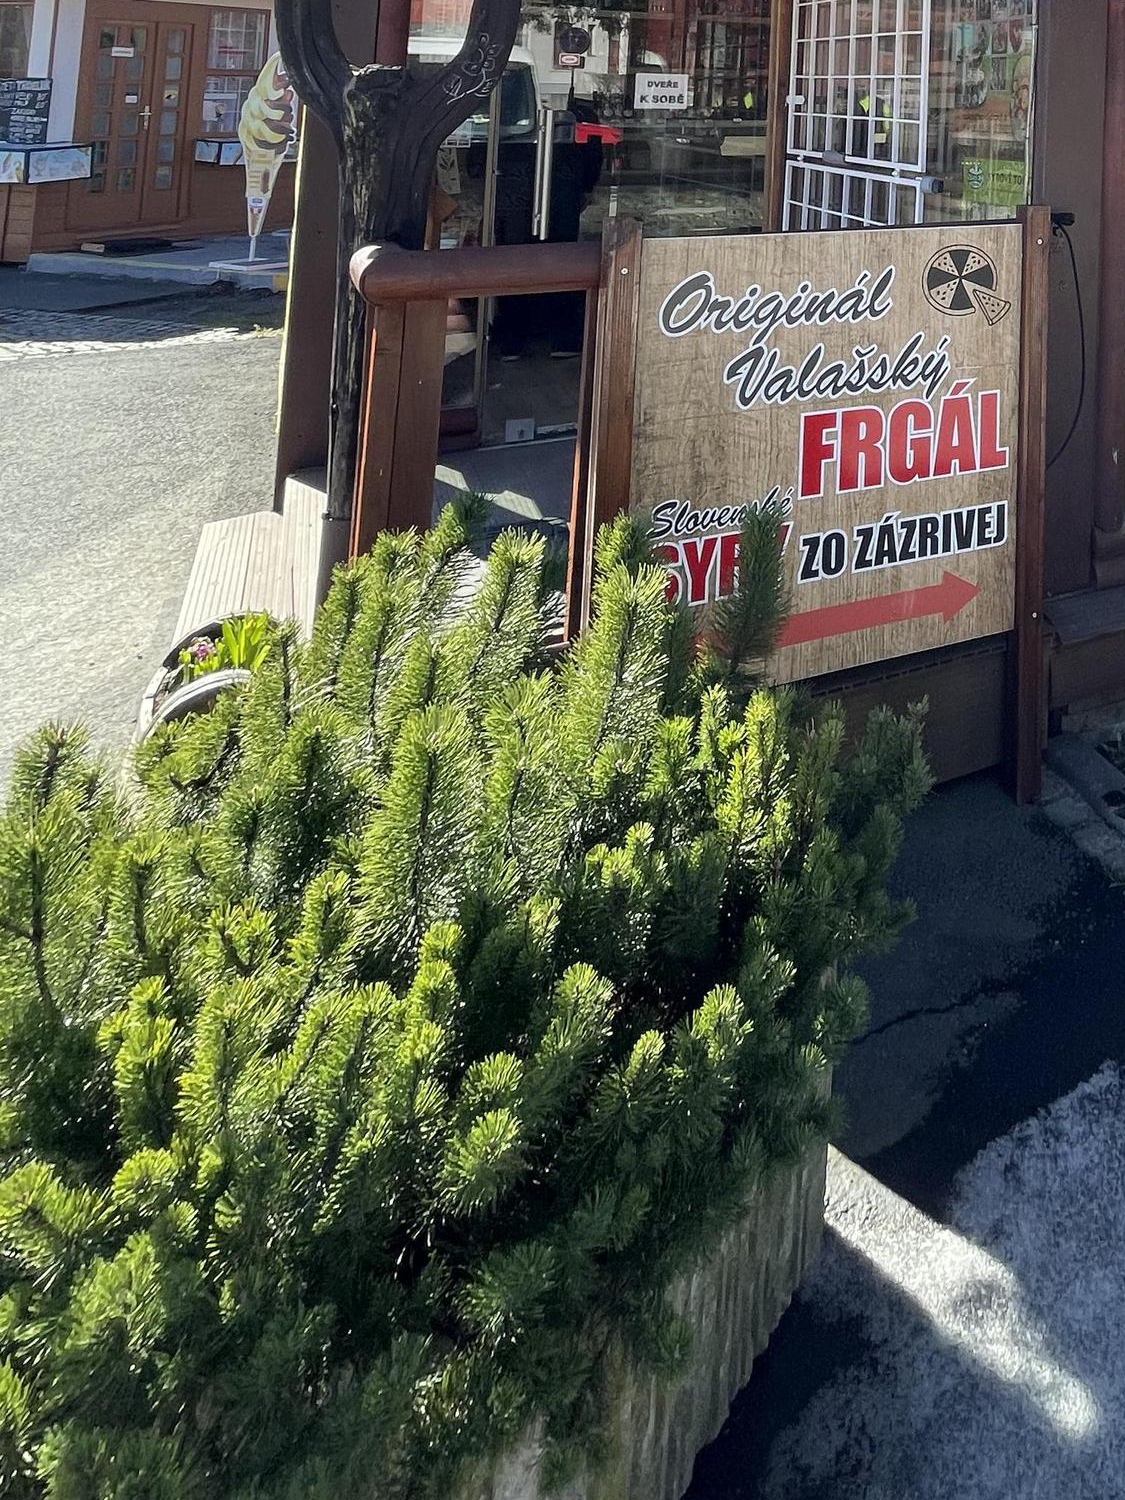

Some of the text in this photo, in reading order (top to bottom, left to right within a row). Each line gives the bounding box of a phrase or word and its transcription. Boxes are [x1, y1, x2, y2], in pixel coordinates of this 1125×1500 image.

[639, 93, 685, 104] K SOBĚ
[647, 79, 679, 89] DVEŘE
[658, 265, 896, 346] Originál
[723, 332, 951, 410] Valašský
[798, 378, 1009, 501] FRGÁL
[798, 529, 850, 584] ZO
[851, 500, 1009, 575] ZÁZRIVEJ
